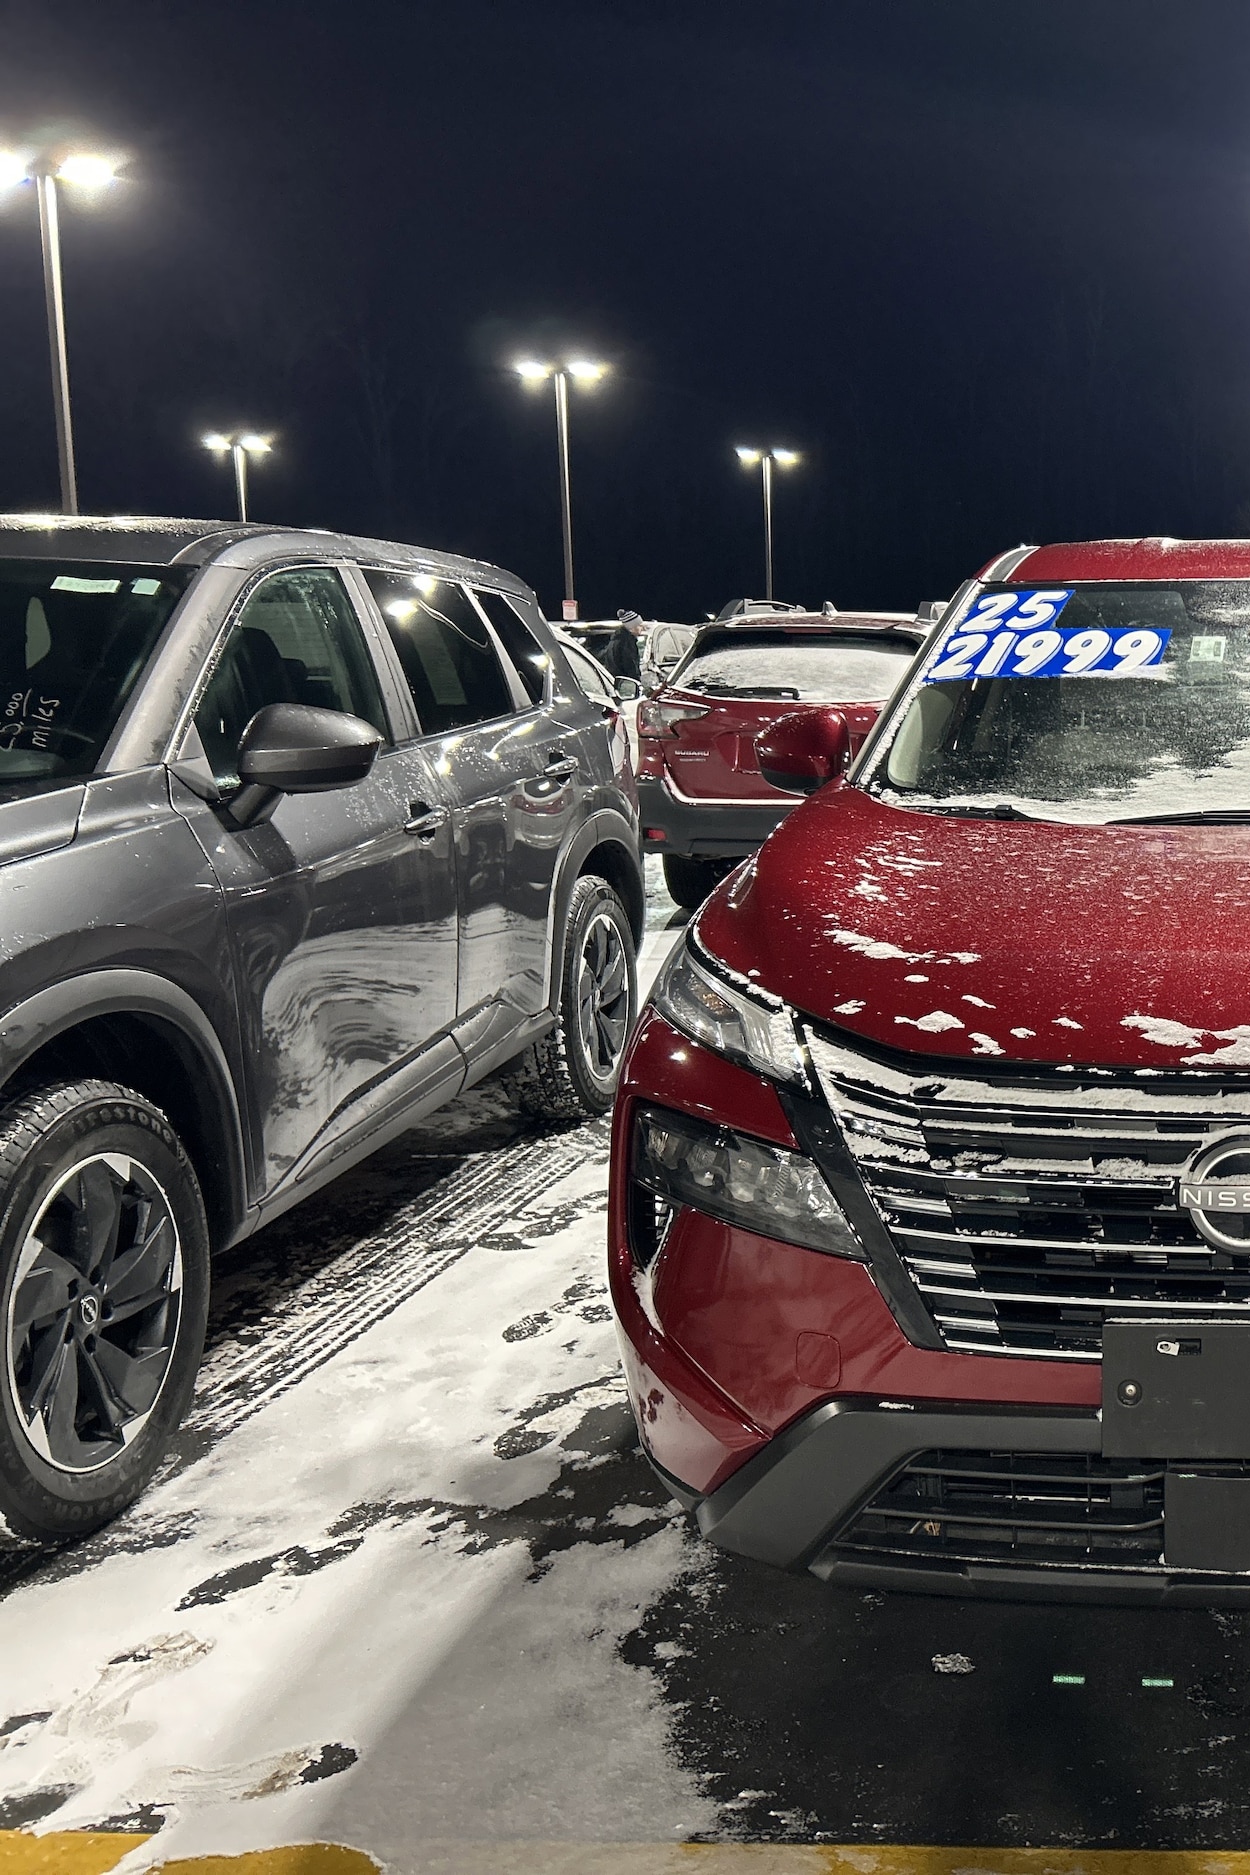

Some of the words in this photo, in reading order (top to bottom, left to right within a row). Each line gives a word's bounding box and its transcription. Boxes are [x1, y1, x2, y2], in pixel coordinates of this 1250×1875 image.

[958, 590, 1068, 633] 25
[927, 629, 1163, 680] 21999
[31, 696, 60, 748] miles
